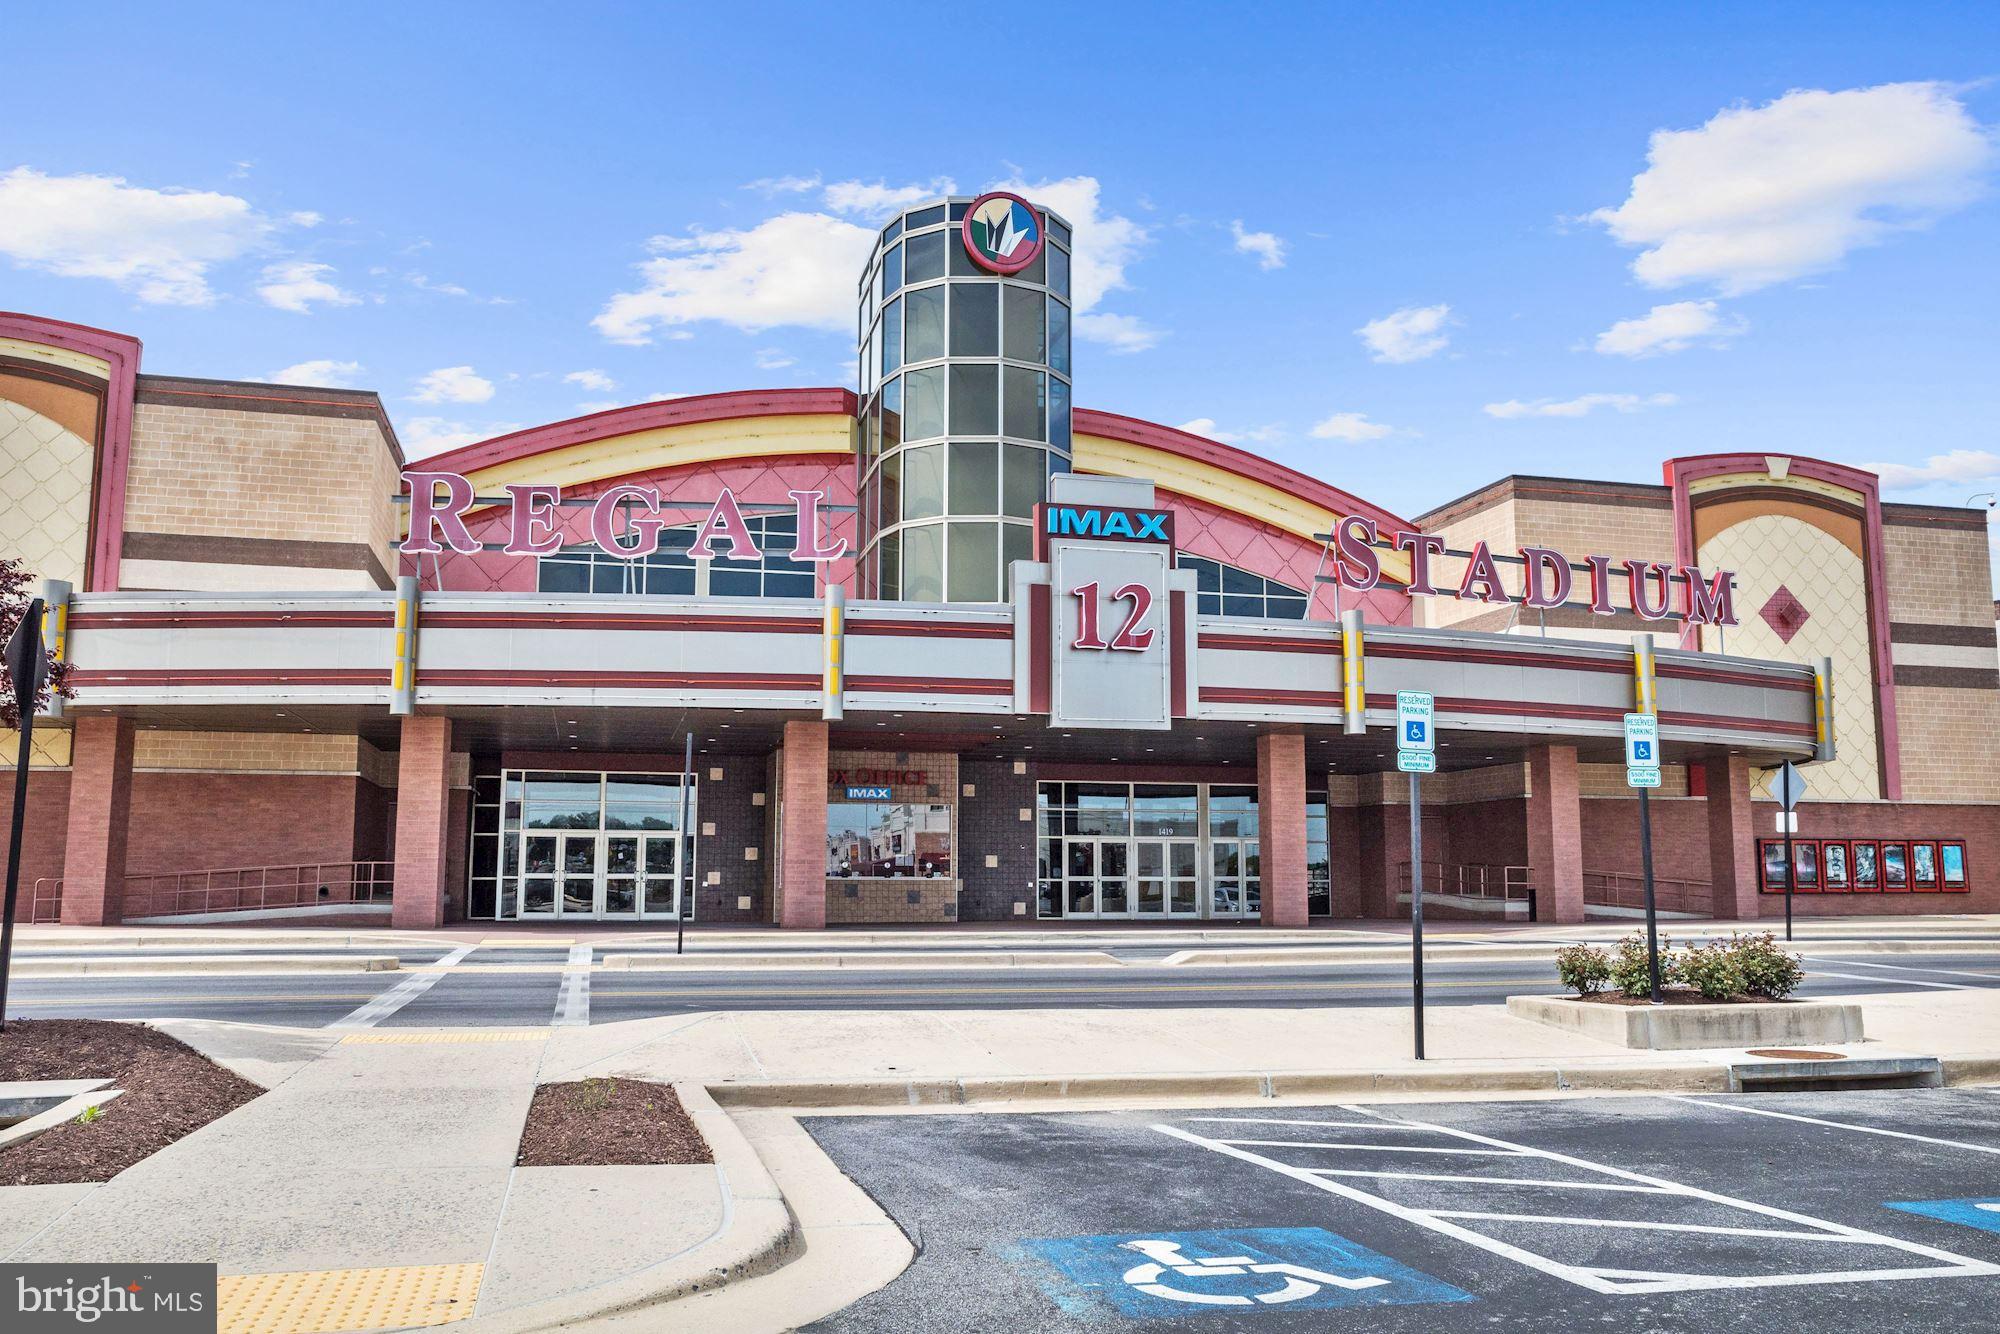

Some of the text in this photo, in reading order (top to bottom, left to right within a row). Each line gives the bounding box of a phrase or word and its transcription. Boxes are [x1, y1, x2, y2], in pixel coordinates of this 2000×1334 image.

[398, 470, 848, 561] REGAL
[1047, 507, 1169, 541] IMAX
[1333, 515, 1739, 626] STADIUM
[1072, 580, 1156, 653] 12
[1400, 696, 1431, 706] RESERVED
[1402, 706, 1429, 715] PARKING
[1627, 718, 1655, 727] RESERVED
[855, 768, 928, 785] OFFICE
[849, 788, 888, 798] IMAX
[1158, 827, 1174, 836] 1419
